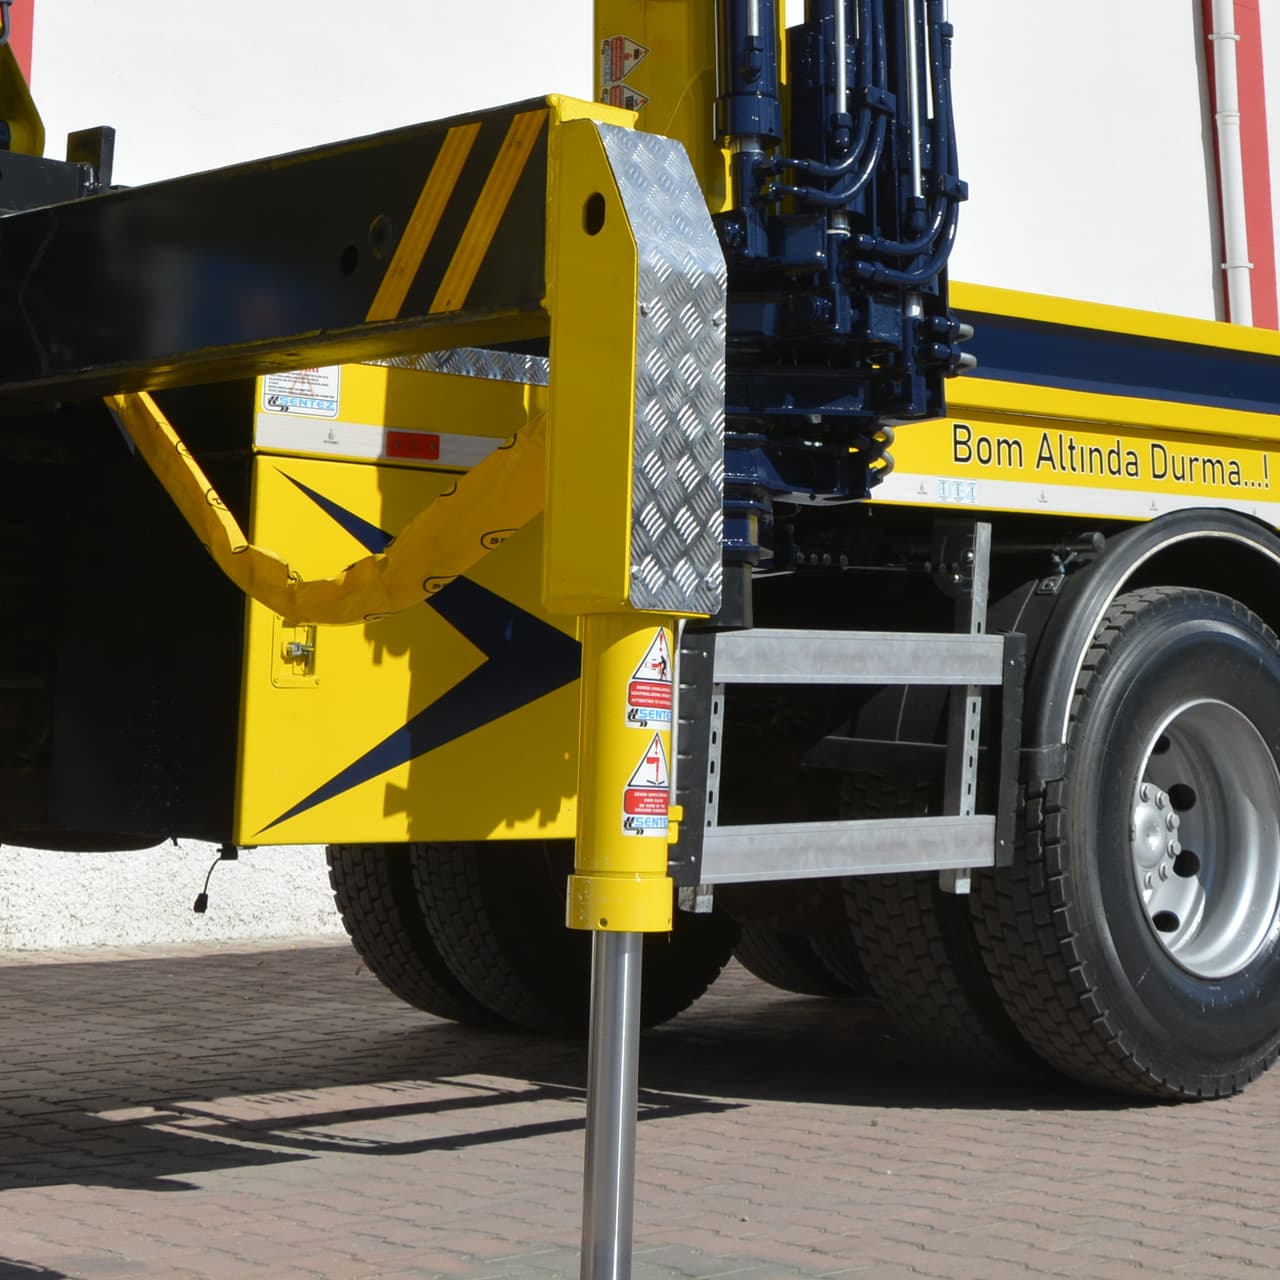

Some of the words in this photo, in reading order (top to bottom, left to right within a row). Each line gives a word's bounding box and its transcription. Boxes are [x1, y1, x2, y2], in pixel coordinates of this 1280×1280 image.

[279, 396, 336, 411] SENTEZ
[953, 423, 1023, 469] Bom
[1036, 431, 1140, 478] Altında
[1151, 443, 1270, 489] Durma...!
[638, 708, 672, 720] SENTE
